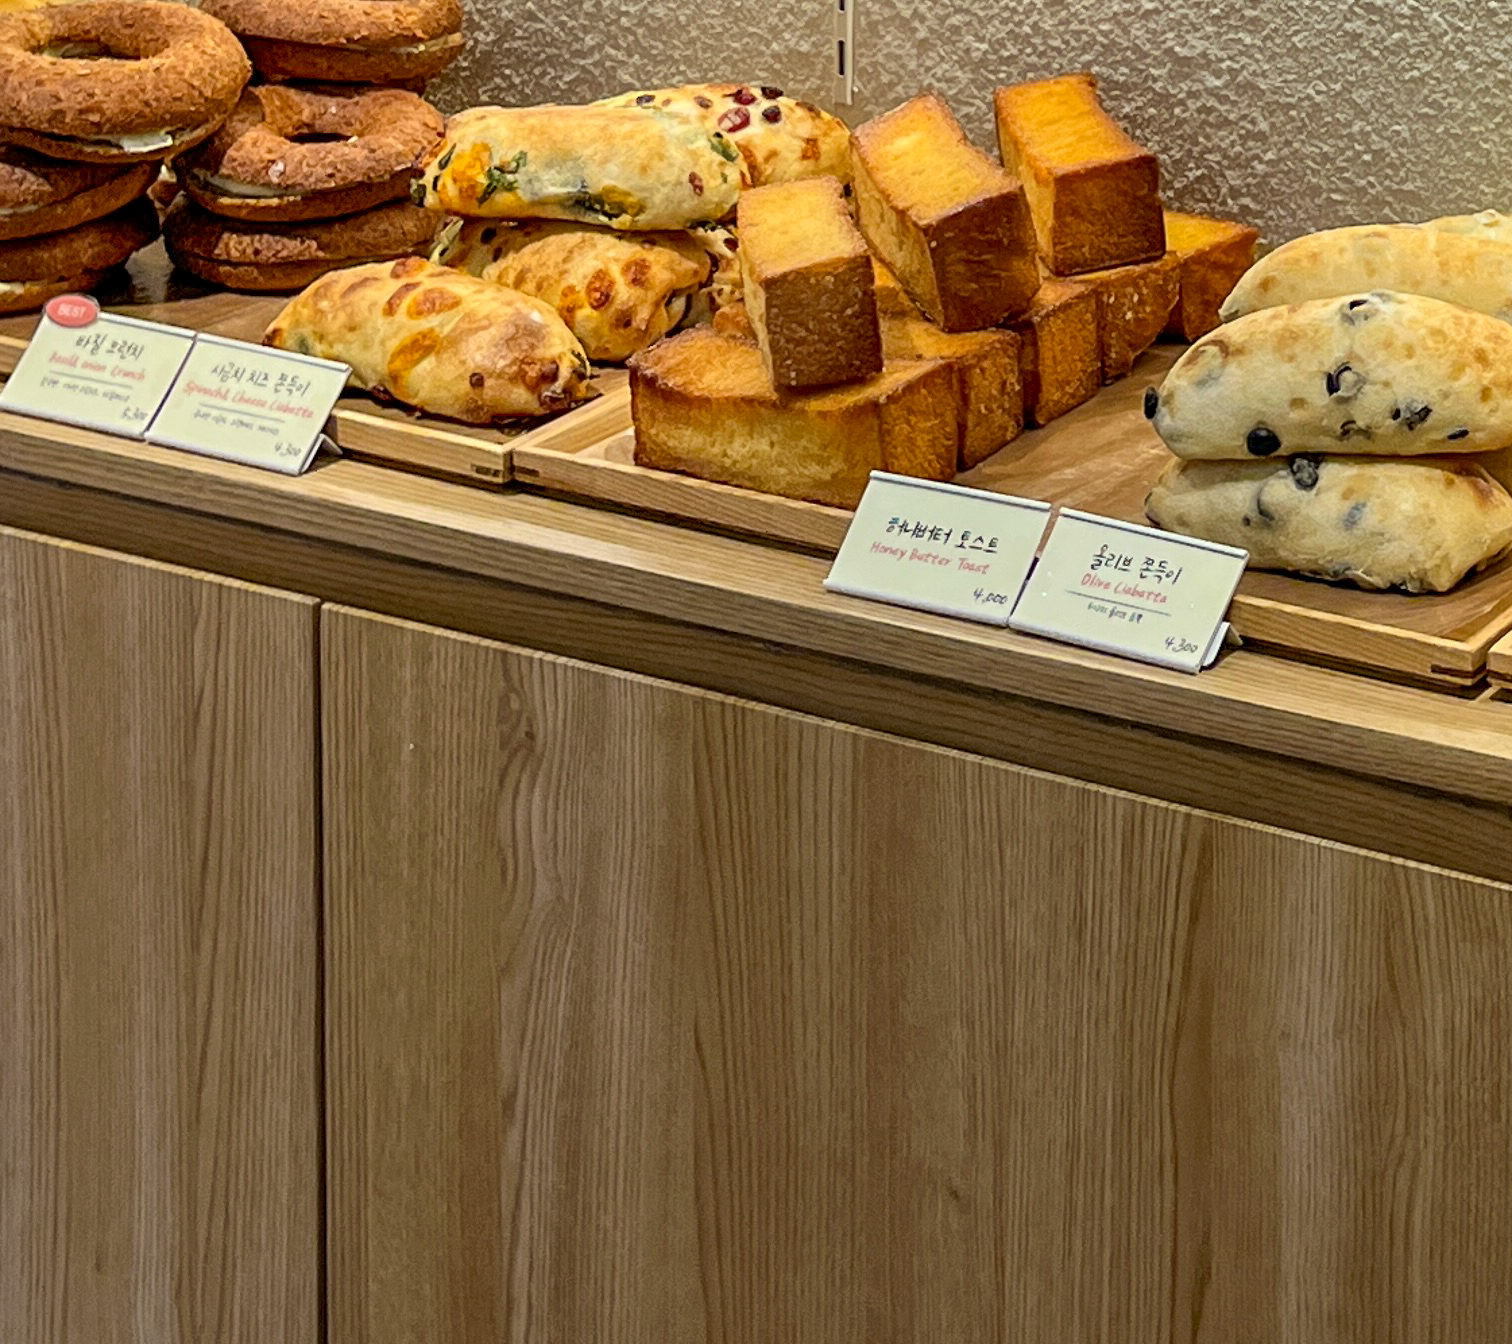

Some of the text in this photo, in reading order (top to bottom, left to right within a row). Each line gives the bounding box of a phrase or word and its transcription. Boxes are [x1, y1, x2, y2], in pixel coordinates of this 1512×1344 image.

[246, 370, 270, 387] 치즈
[955, 530, 999, 554] 토스트
[870, 541, 991, 575] Honey Butter Toast
[1090, 543, 1134, 572] 올리브
[1080, 572, 1111, 590] Olive
